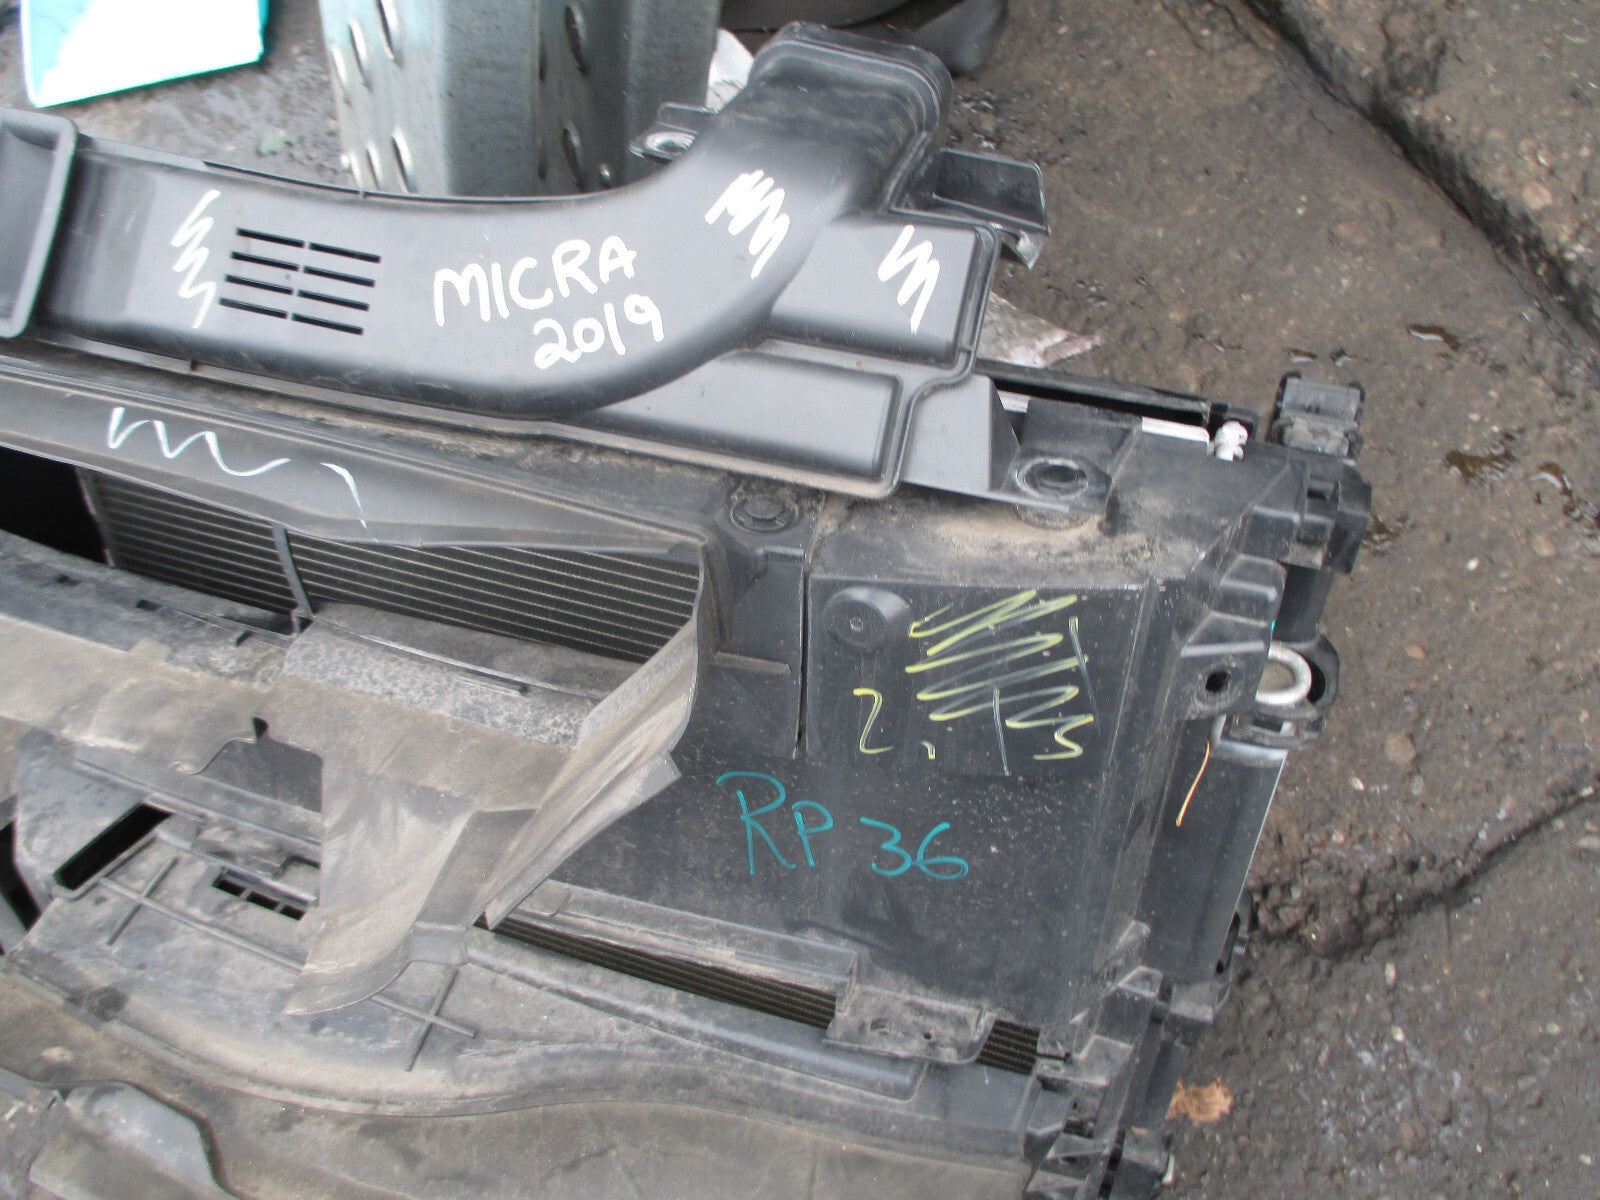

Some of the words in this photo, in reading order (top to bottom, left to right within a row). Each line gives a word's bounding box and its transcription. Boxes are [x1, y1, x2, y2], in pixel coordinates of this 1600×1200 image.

[433, 235, 637, 327] MICRA
[532, 293, 664, 369] 2019
[716, 771, 833, 875] RP
[859, 816, 969, 880] 36
